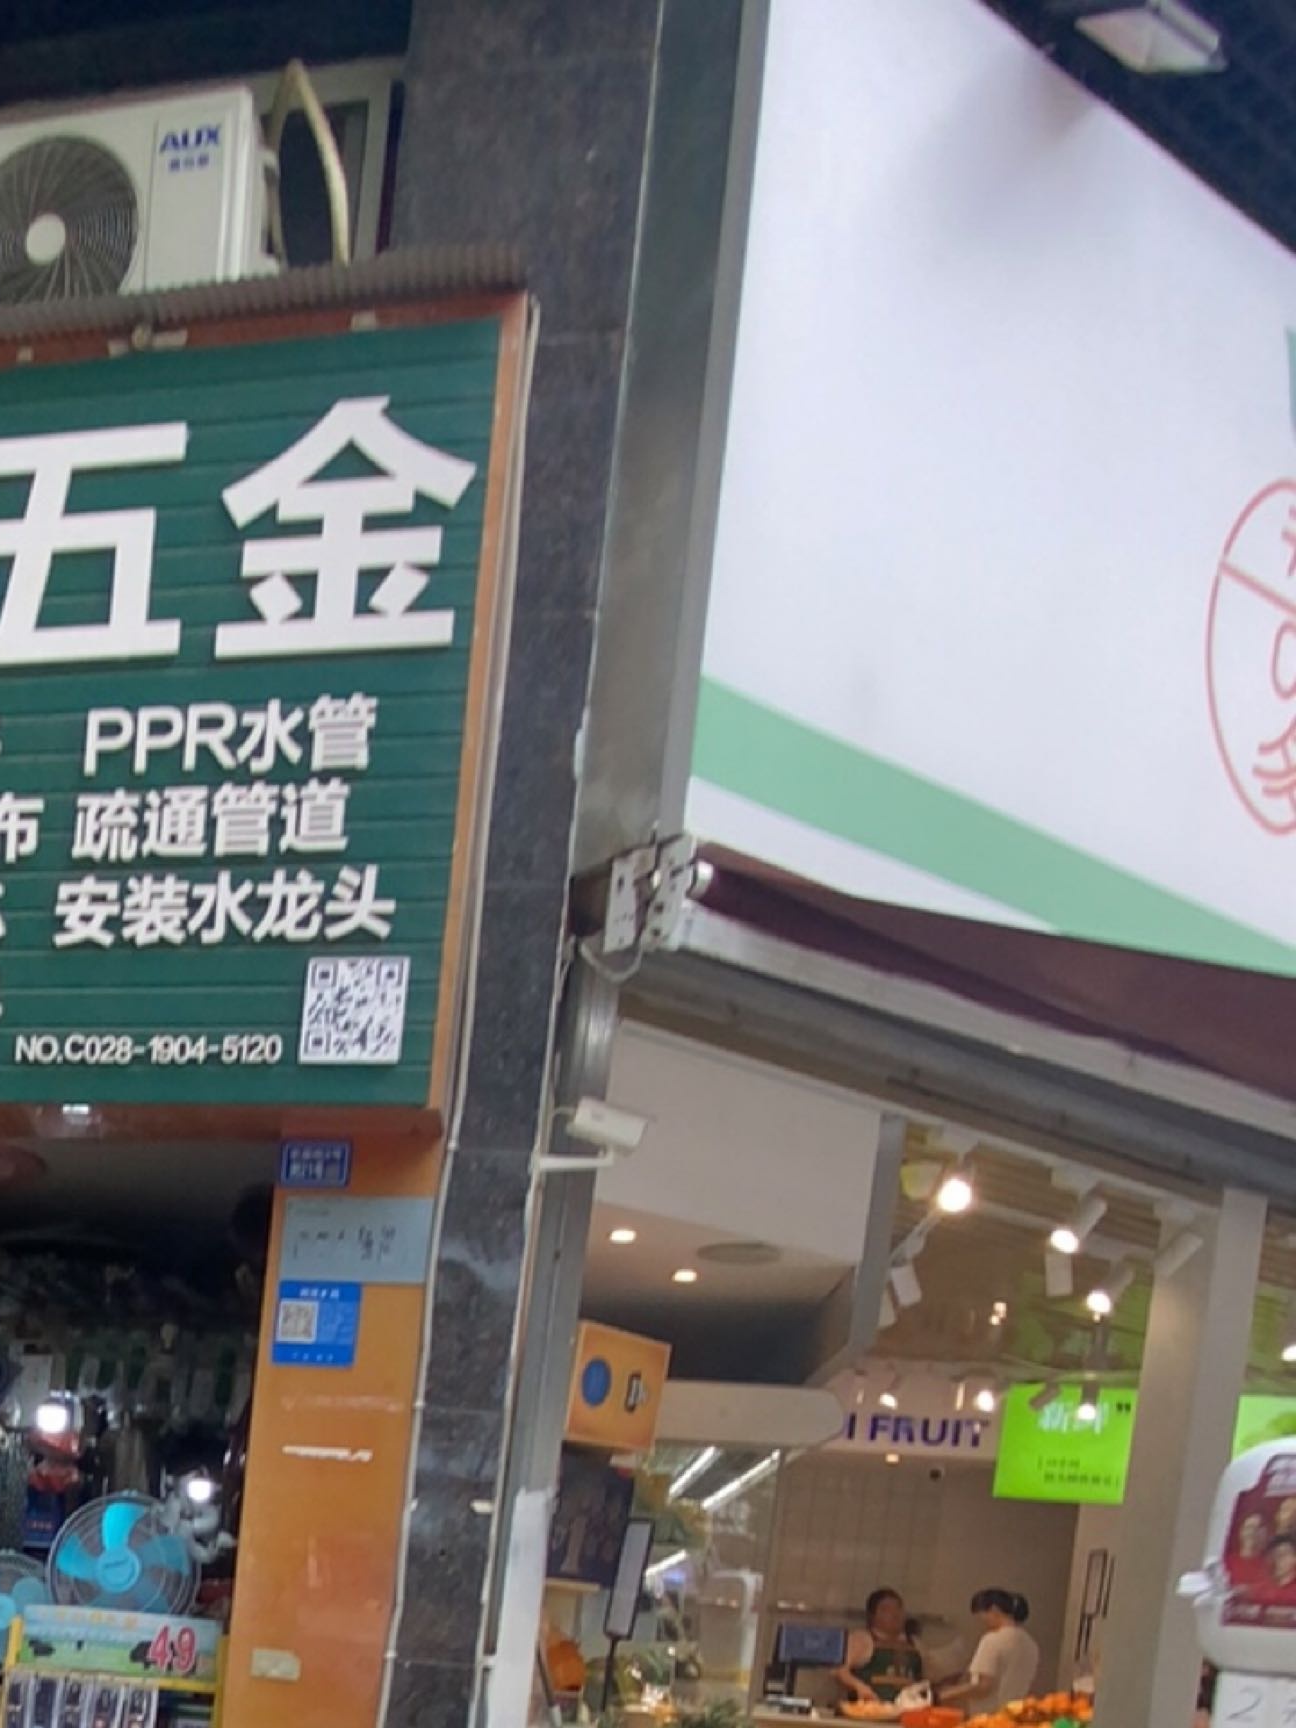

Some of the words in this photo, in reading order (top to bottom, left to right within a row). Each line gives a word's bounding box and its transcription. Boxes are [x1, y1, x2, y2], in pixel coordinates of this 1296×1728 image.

[159, 122, 221, 152] AUX
[84, 693, 378, 777] PPR水管
[71, 781, 349, 861] 疏通管道
[52, 864, 397, 949] 安装水龙头
[14, 1033, 283, 1066] NO.C028-1904-5120
[869, 1413, 990, 1449] FRUIT
